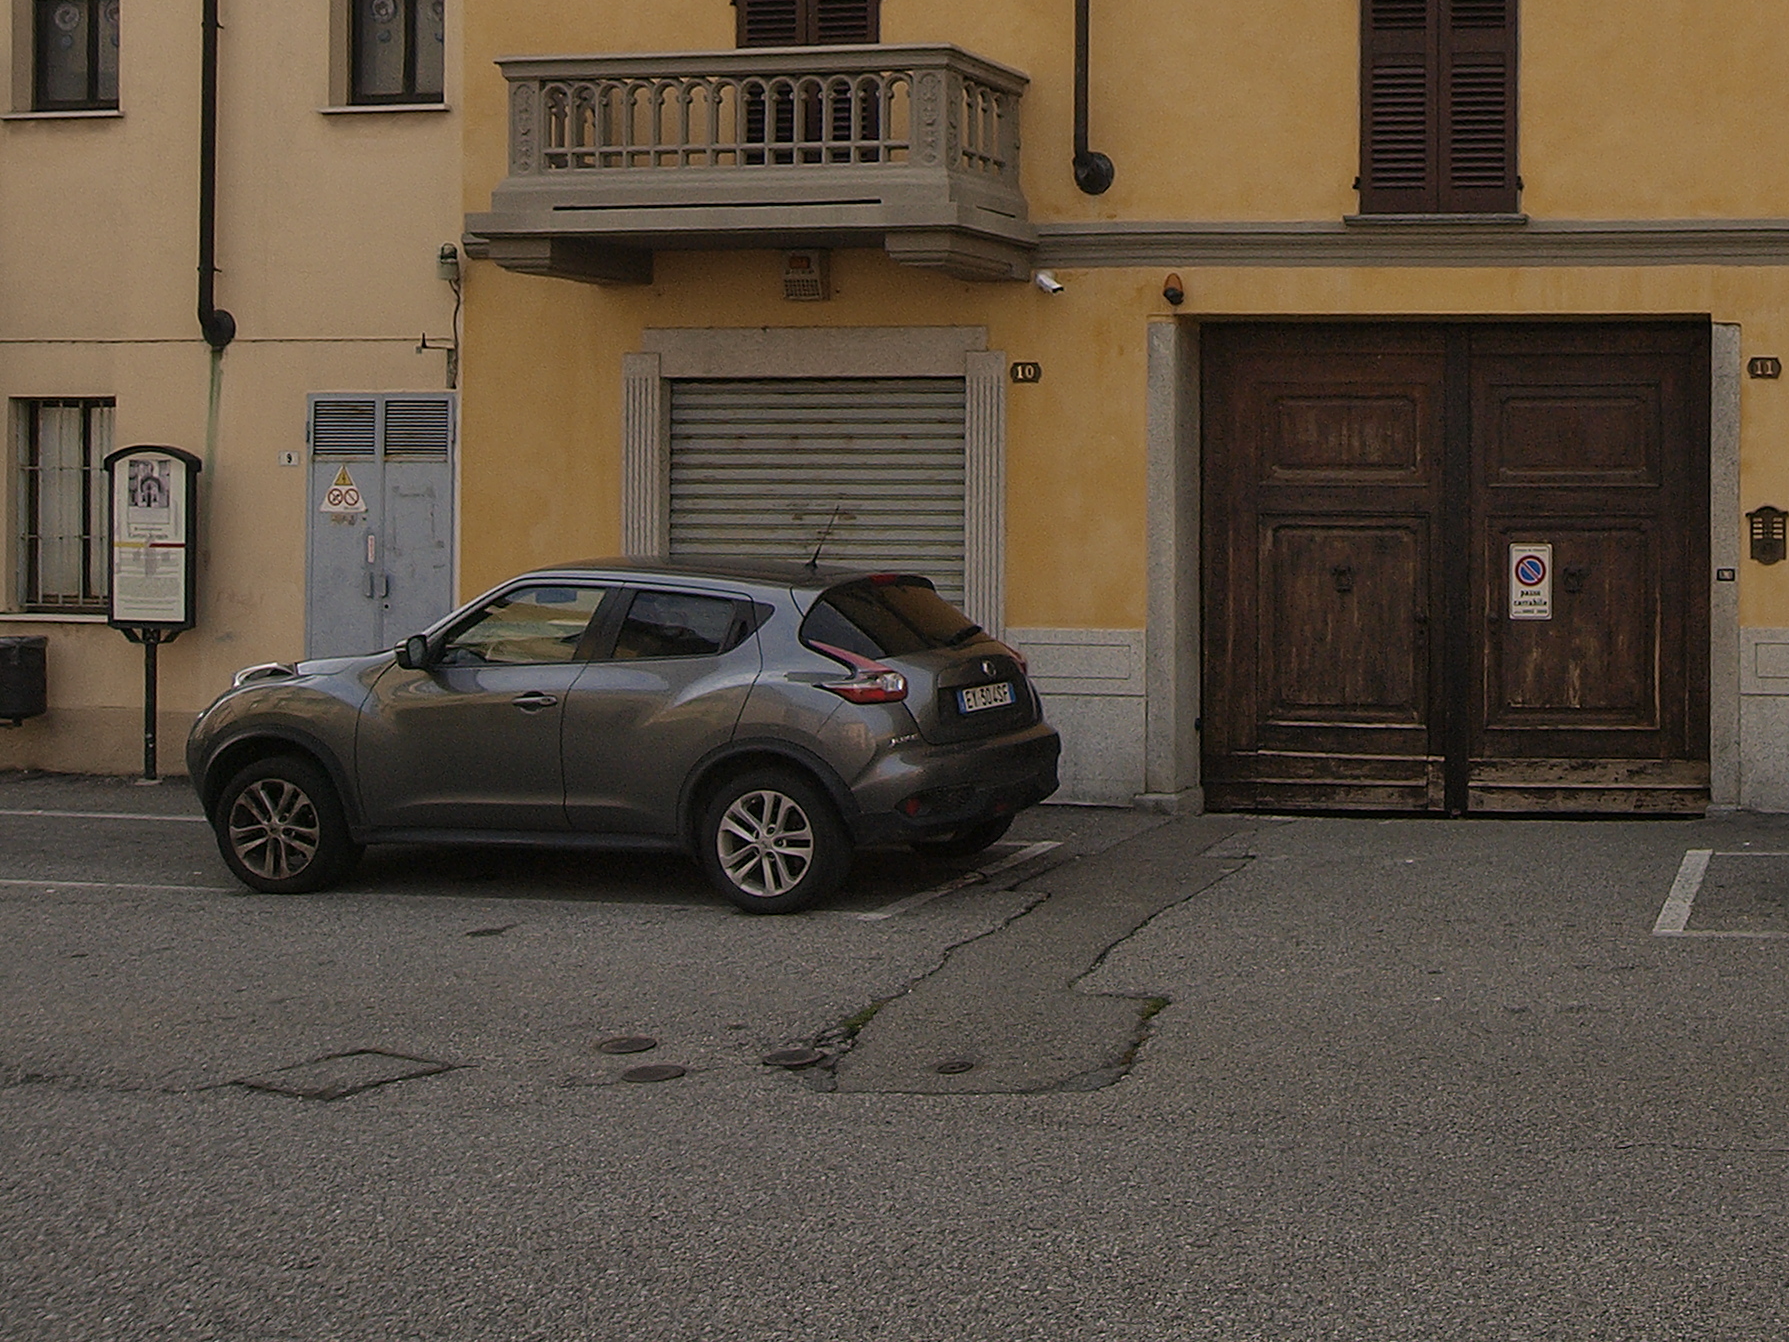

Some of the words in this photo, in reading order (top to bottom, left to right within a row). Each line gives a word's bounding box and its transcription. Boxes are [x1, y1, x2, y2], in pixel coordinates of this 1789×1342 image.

[1017, 364, 1035, 379] 10
[1754, 360, 1775, 376] 11
[286, 453, 293, 464] 9
